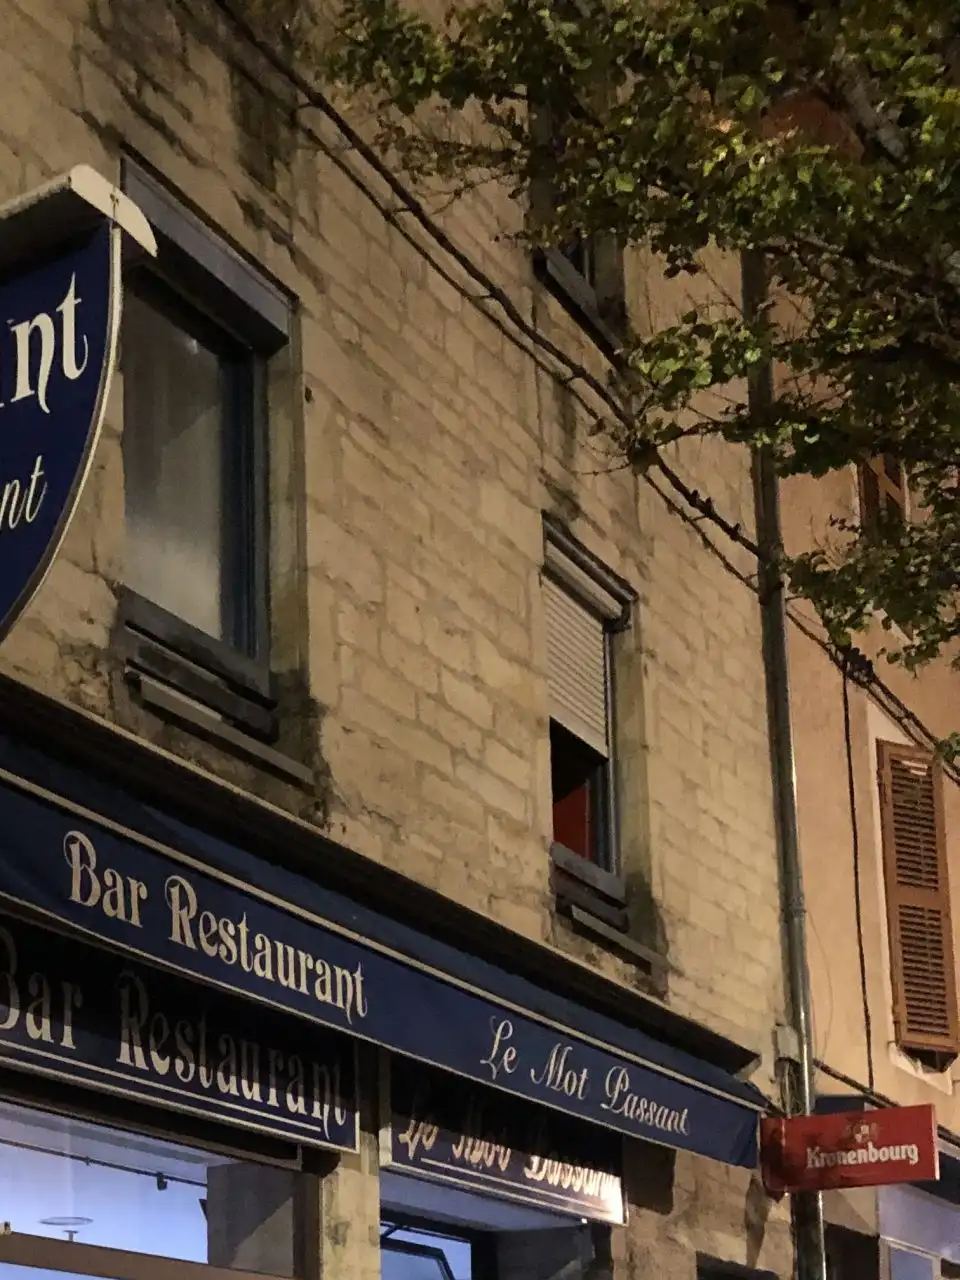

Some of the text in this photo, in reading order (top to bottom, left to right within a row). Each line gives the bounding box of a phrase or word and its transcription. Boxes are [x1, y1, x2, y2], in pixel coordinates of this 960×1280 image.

[63, 830, 369, 1024] Bar Restaurant
[115, 970, 348, 1140] Restaurant
[480, 1015, 690, 1136] Le Mot Passant
[806, 1141, 919, 1169] Kronenbourg
